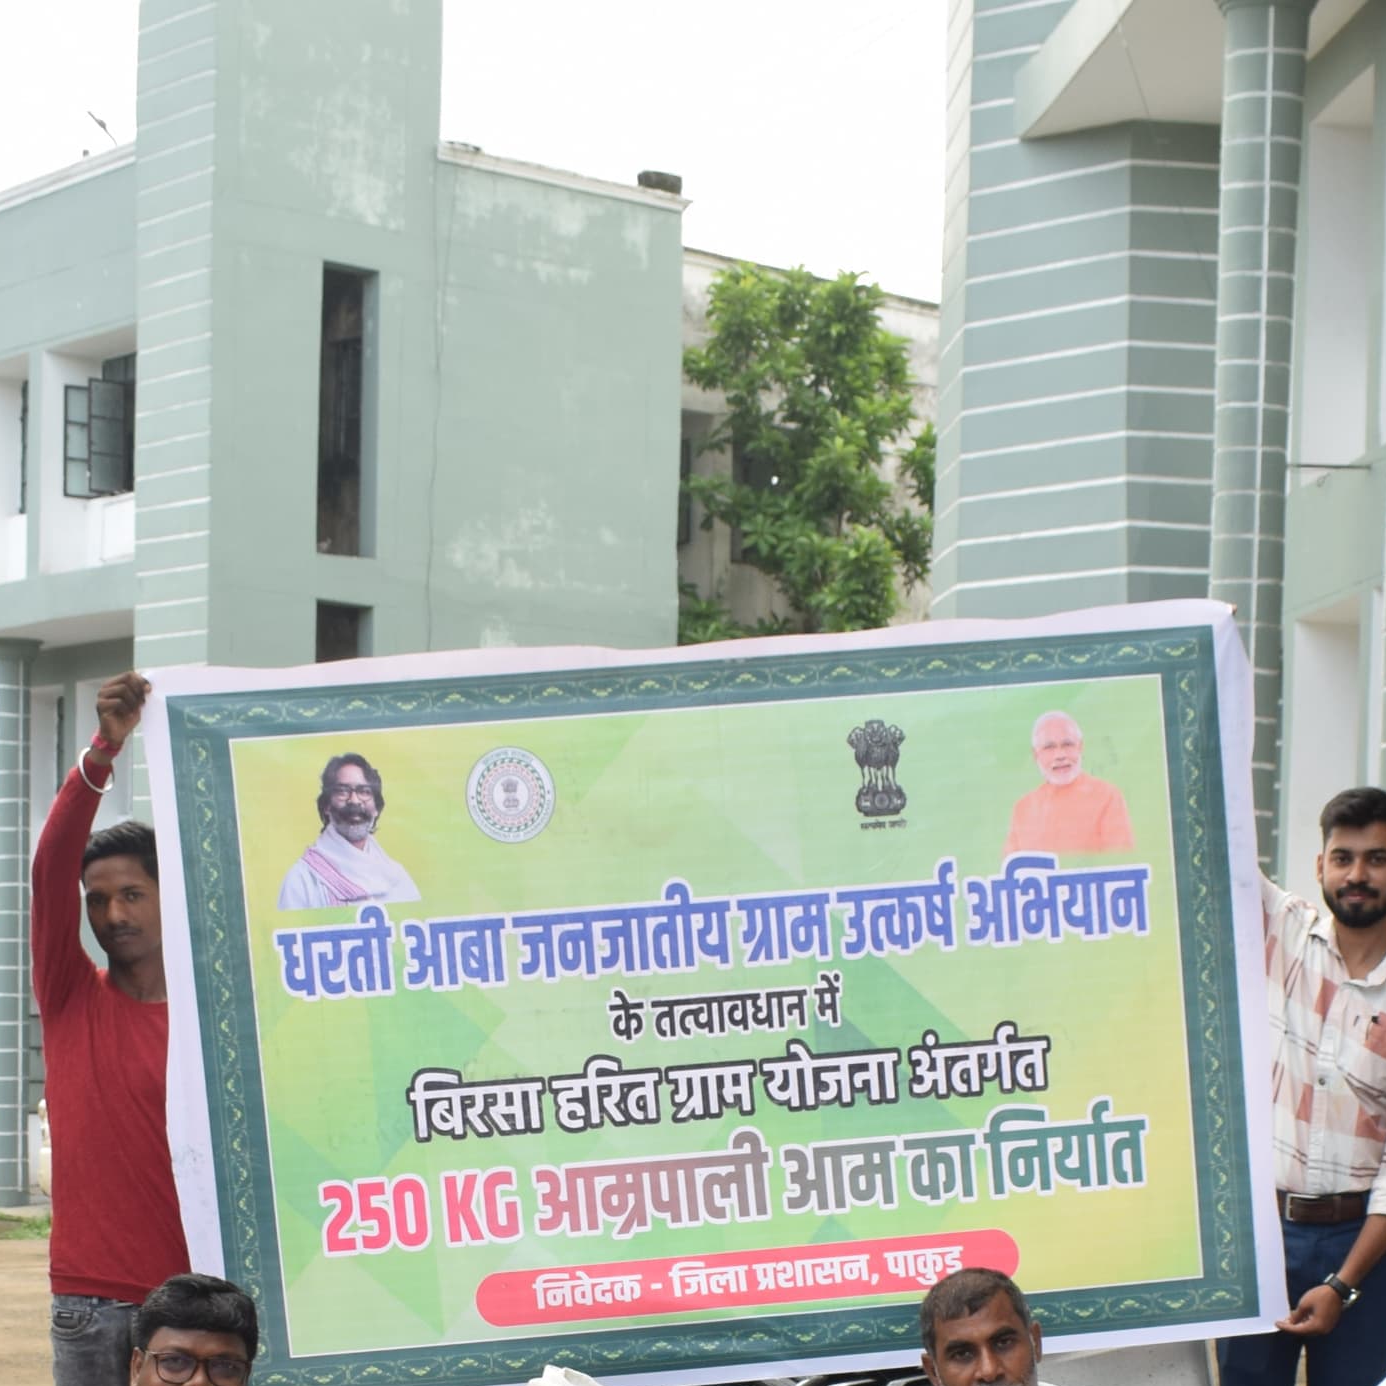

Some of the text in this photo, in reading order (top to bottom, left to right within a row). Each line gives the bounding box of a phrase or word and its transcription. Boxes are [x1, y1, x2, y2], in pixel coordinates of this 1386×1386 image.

[276, 855, 1149, 996] धरती आबा जनजातीय ग्राम उत्कर्ष अभियान
[609, 974, 840, 1040] के तत्वावधान में
[409, 1023, 1050, 1140] बिरसा हरित ग्राम योजना अंतर्गत
[322, 1099, 1147, 1253] 250 KG आम्रपाली आम का निर्यात
[533, 1271, 643, 1309] निवेदक
[668, 1261, 748, 1299] जिला
[752, 1253, 879, 1292] प्रशासन,
